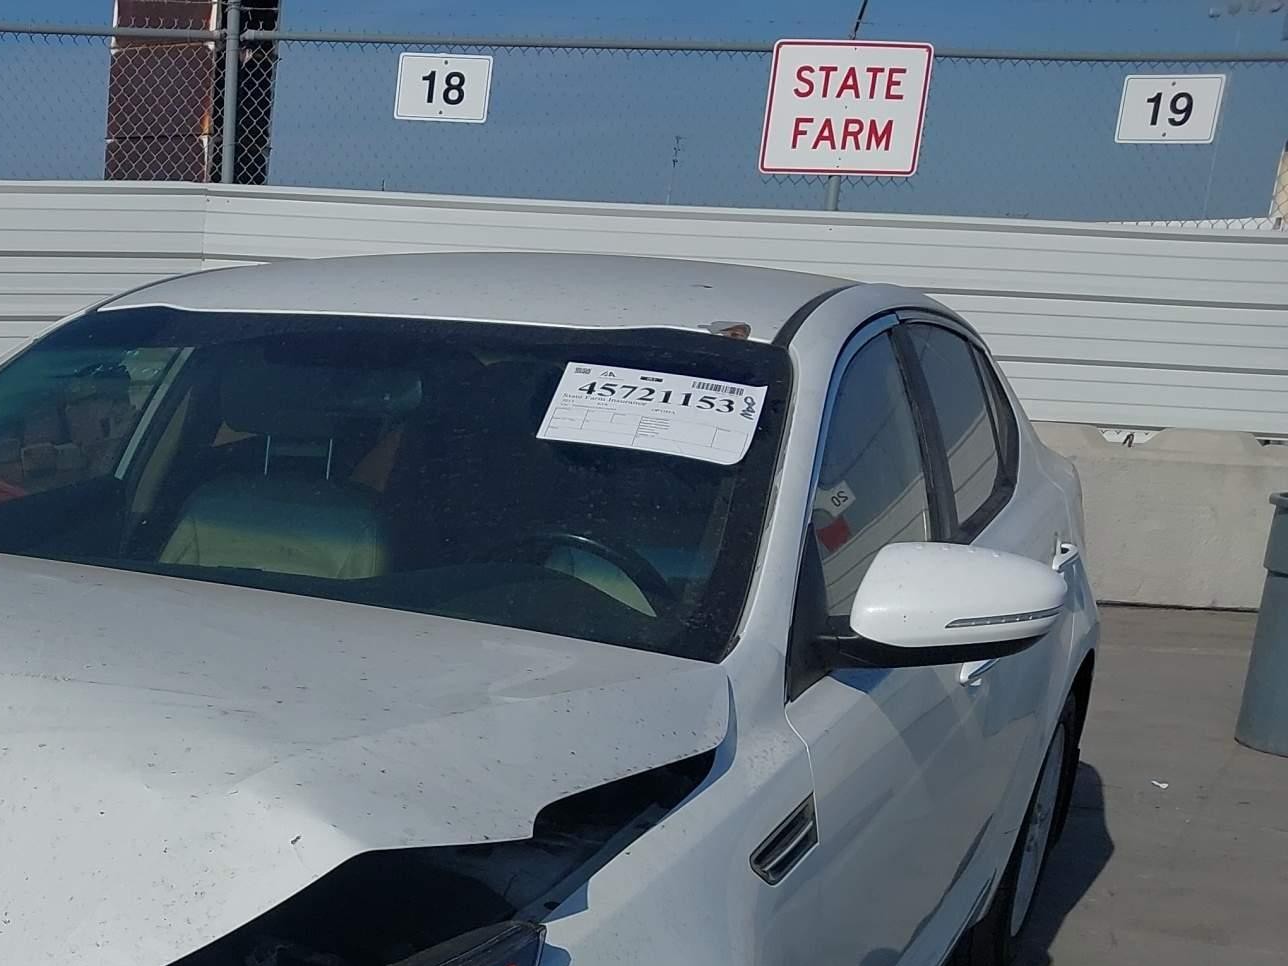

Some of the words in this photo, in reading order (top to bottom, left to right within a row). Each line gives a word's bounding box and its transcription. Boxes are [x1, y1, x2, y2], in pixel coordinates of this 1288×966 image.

[421, 69, 467, 107] 18
[792, 65, 908, 101] STATE
[1145, 91, 1195, 128] 19
[790, 118, 895, 153] FARM
[578, 380, 735, 415] 45721153
